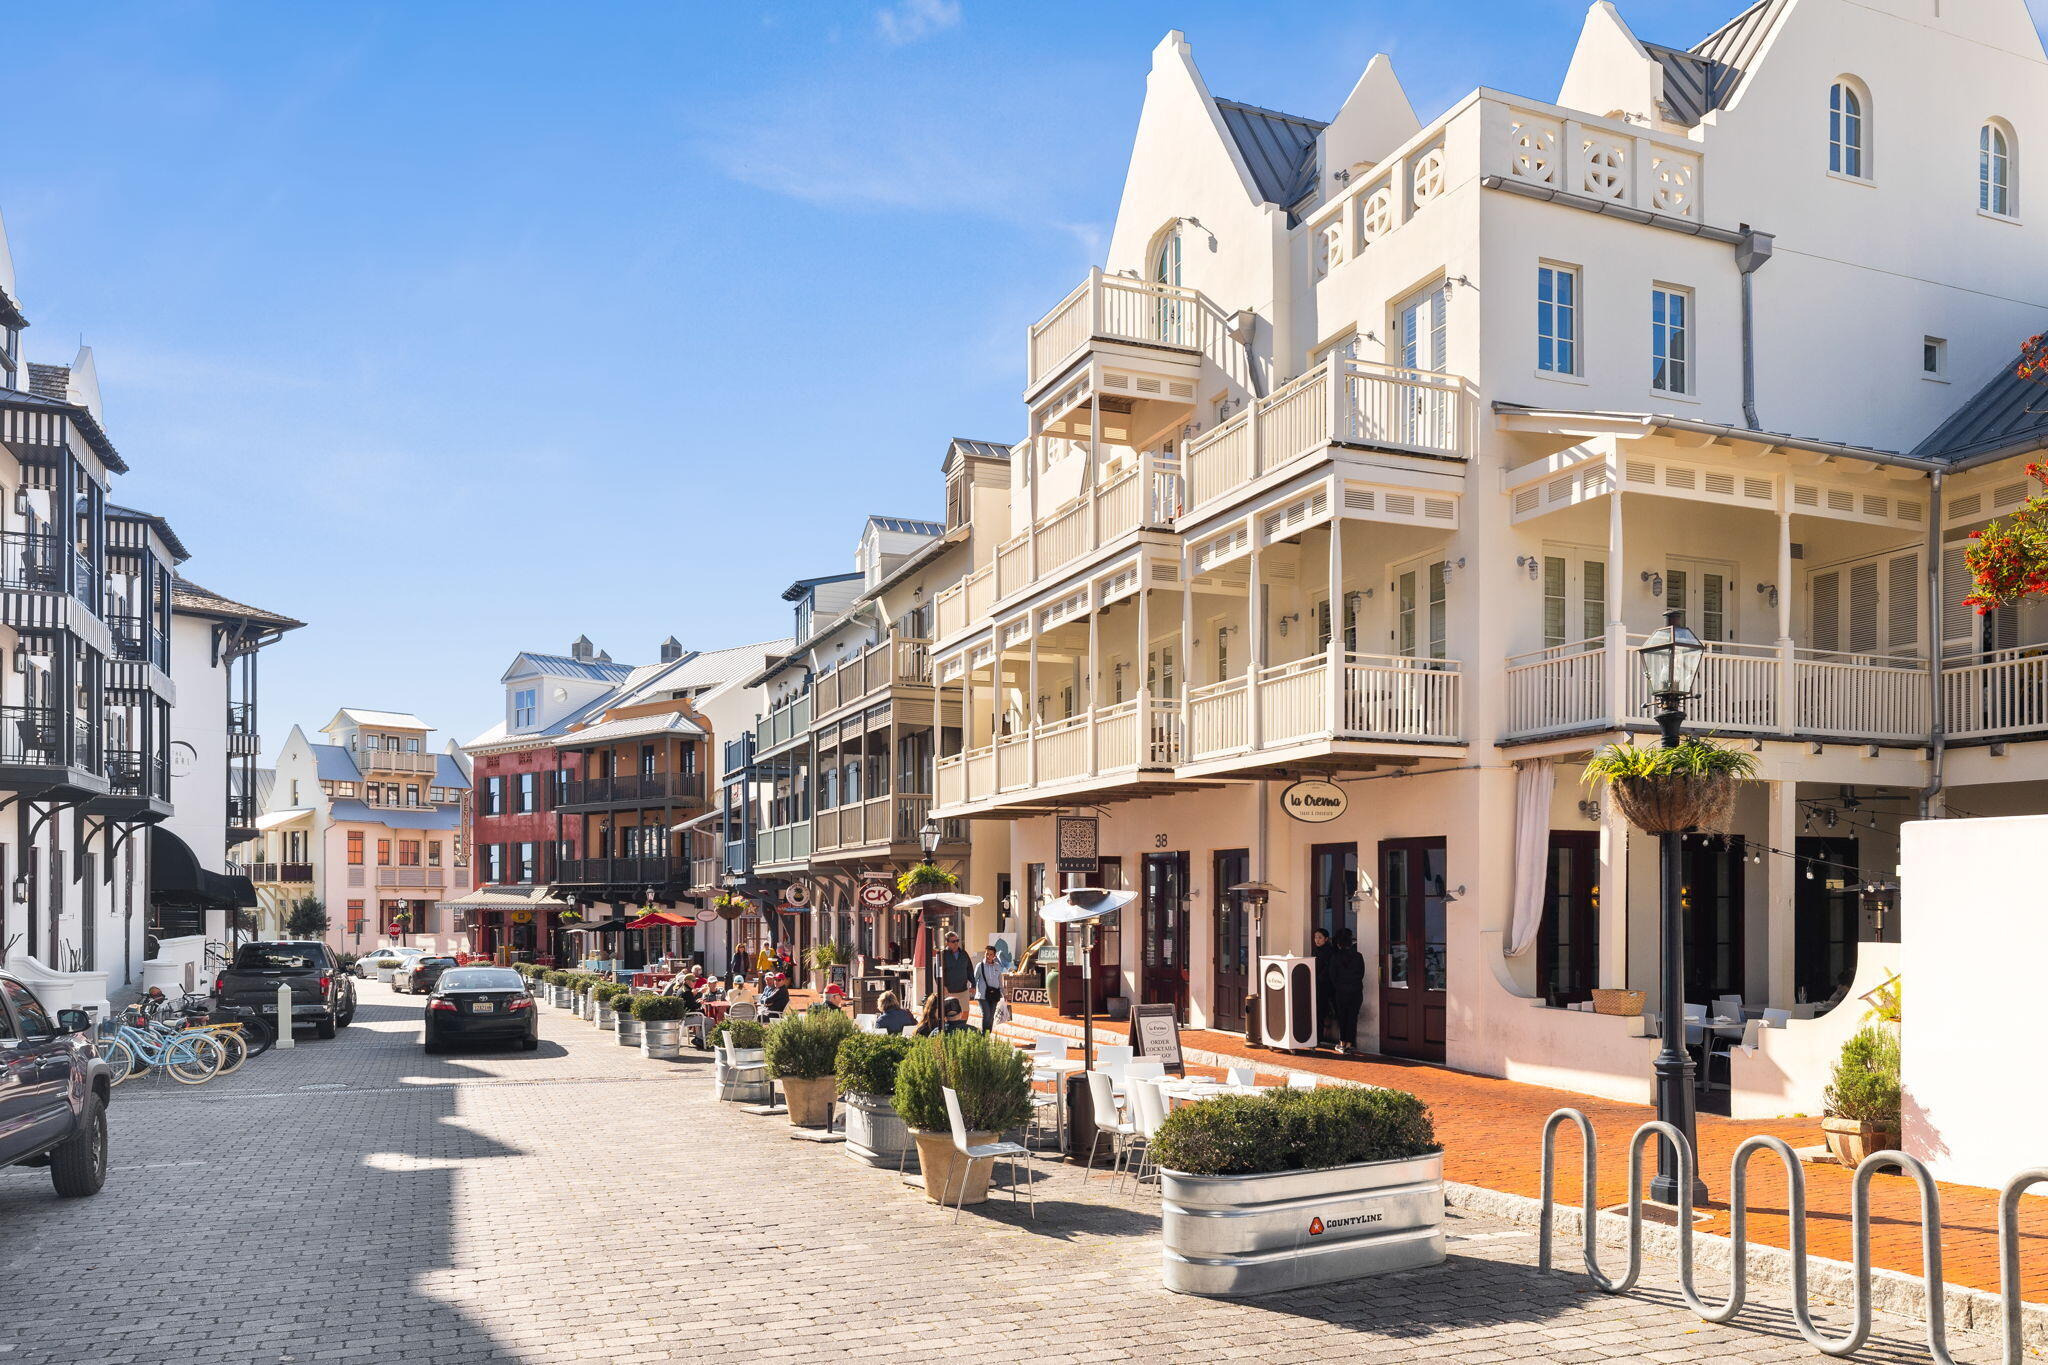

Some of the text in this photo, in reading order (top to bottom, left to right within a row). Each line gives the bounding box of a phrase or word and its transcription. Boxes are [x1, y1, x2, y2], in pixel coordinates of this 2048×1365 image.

[1291, 794, 1341, 806] la Crema
[1155, 833, 1168, 848] 38
[865, 889, 889, 901] CK
[1014, 990, 1049, 1003] CRABS
